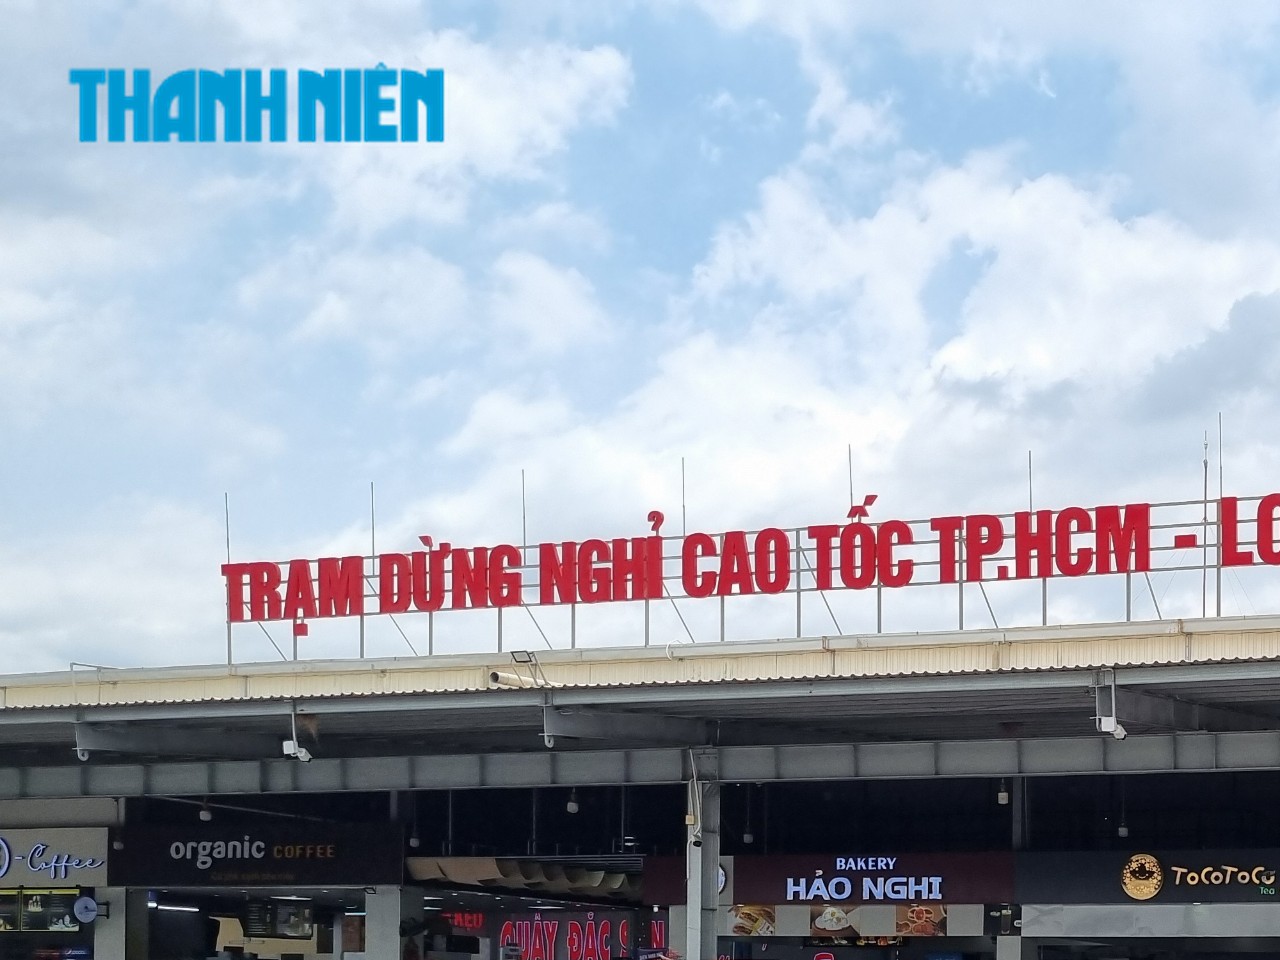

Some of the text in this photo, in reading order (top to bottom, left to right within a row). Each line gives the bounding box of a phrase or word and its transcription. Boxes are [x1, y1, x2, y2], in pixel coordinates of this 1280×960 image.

[221, 555, 363, 636] TRẠM
[379, 535, 522, 614] DỪNG
[539, 511, 664, 606] NGHỈ
[682, 526, 790, 598] CAO
[808, 494, 914, 591] TỐC
[930, 503, 1151, 584] TP.HCM
[27, 842, 105, 880] Coffee
[169, 835, 266, 870] organic
[273, 844, 336, 859] COFFEE
[836, 857, 897, 870] BAKERY
[786, 869, 943, 901] HẢO NGHI
[619, 918, 665, 959] SN
